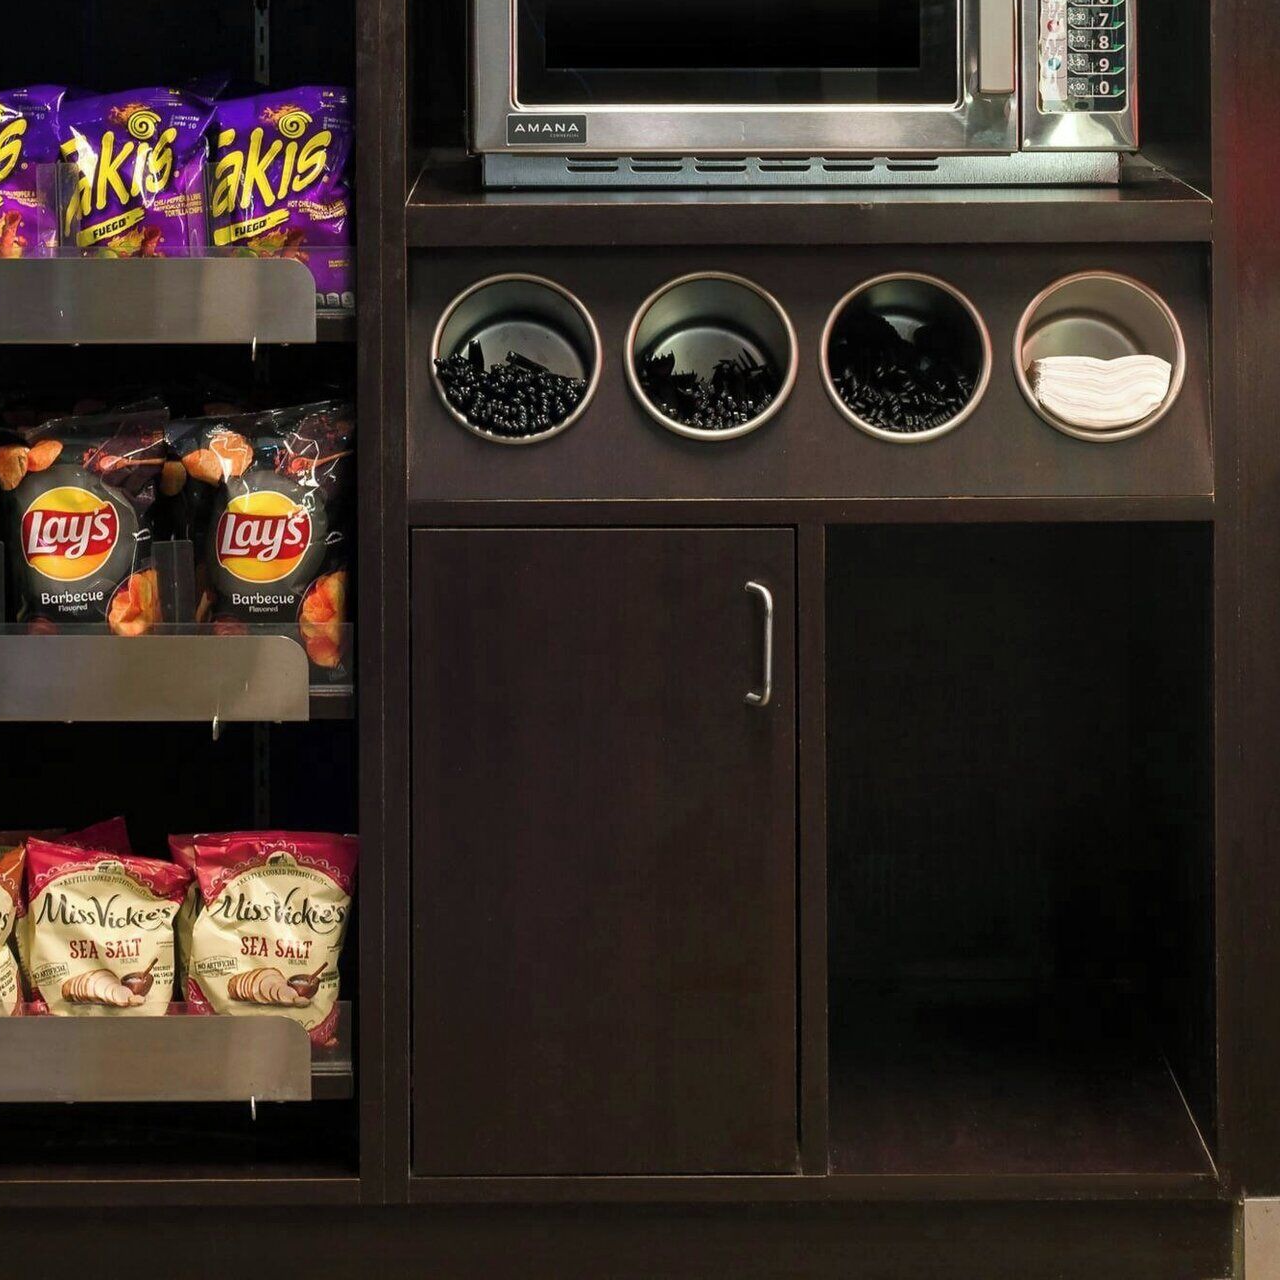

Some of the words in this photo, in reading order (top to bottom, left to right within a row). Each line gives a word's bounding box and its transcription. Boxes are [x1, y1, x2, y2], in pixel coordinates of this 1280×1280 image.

[1099, 13, 1109, 26] 7
[1099, 35, 1109, 49] 8
[1099, 58, 1109, 71] 9
[1099, 81, 1109, 95] 0
[514, 123, 579, 133] AMANA
[92, 219, 127, 240] FUEGO
[234, 219, 267, 238] FUEGO
[28, 508, 112, 559] Lay's
[221, 510, 305, 562] Lay's
[41, 590, 104, 605] Barbecue
[232, 593, 294, 606] Barbecue
[57, 603, 88, 612] Flavored
[248, 605, 279, 613] Flavored
[36, 893, 96, 925] Miss
[87, 894, 171, 931] Vickie's
[210, 893, 270, 921] Miss
[70, 940, 99, 959] SEA
[105, 938, 142, 959] SALT
[240, 936, 269, 957] SEA
[275, 938, 312, 958] SALT
